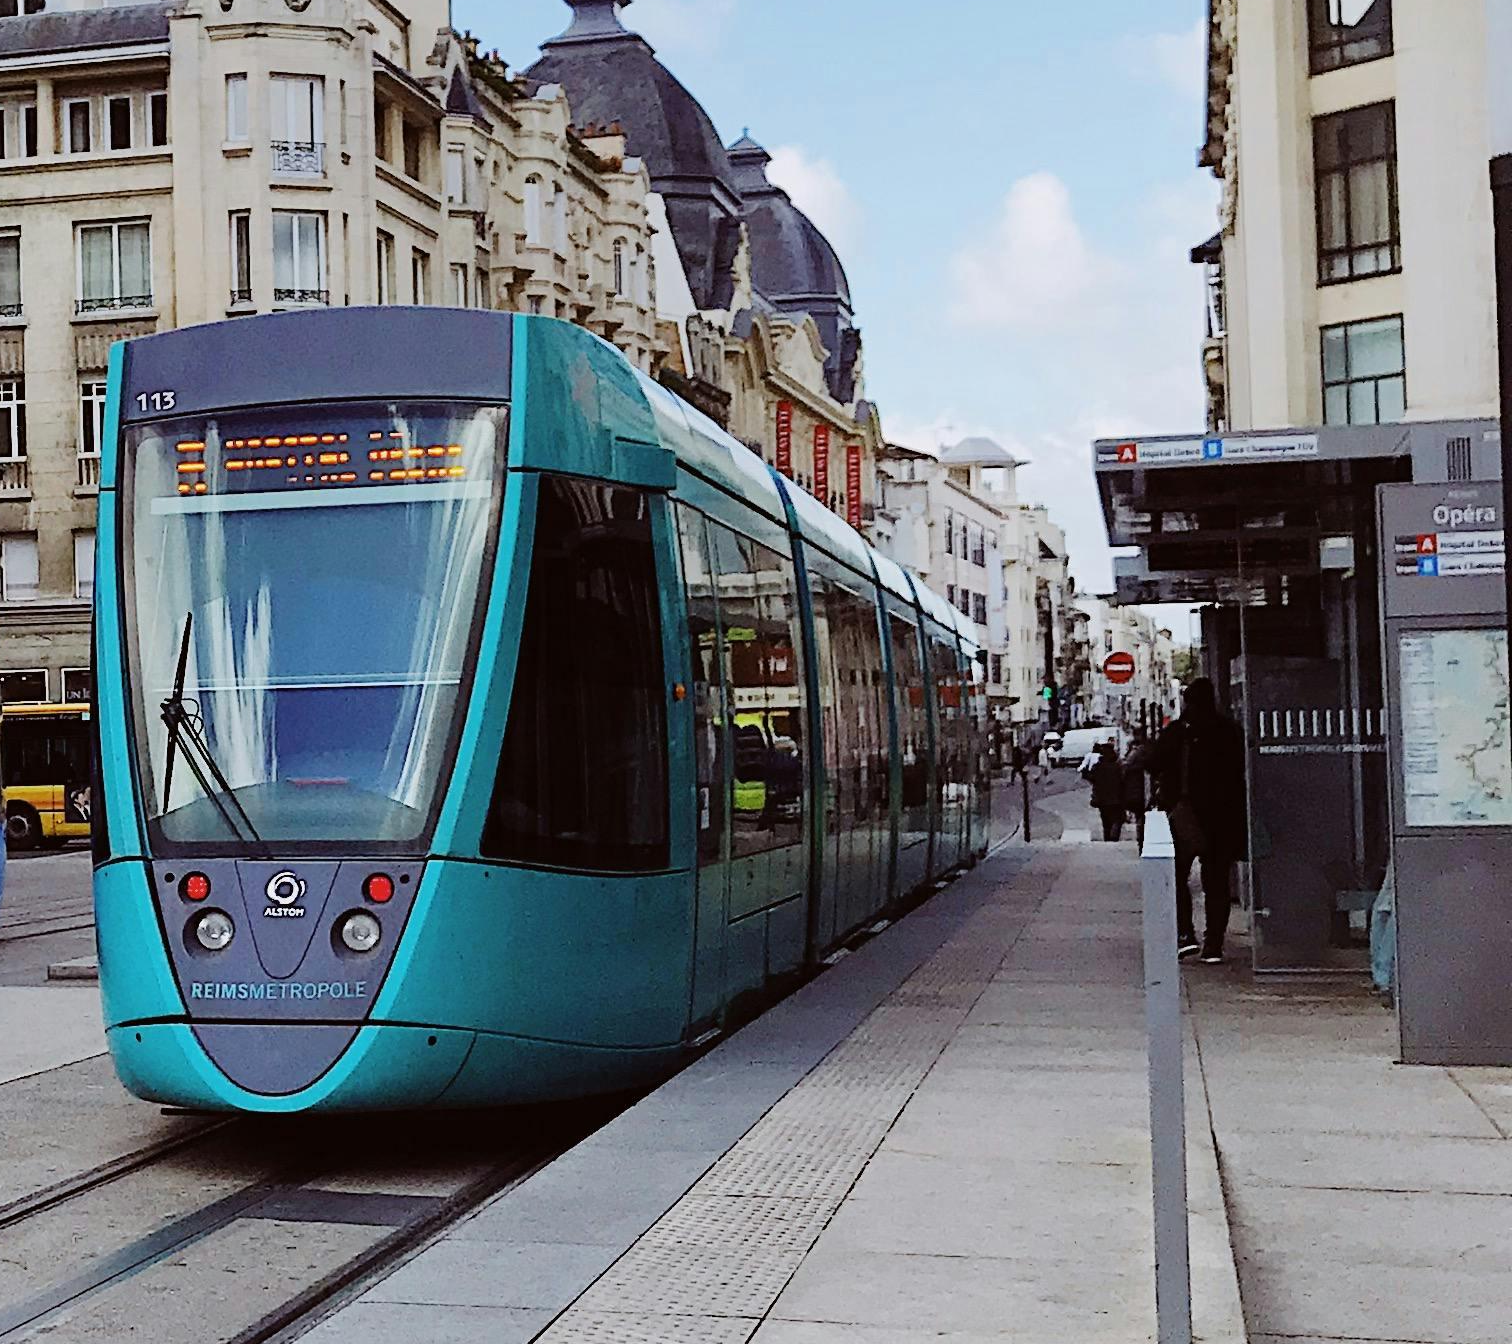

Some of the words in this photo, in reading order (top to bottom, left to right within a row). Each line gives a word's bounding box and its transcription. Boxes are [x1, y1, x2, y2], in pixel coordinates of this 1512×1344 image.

[136, 391, 176, 412] 113
[1123, 447, 1133, 459] A
[1433, 504, 1495, 528] Opéra
[1422, 537, 1434, 551] A
[263, 907, 306, 917] ALSTOM
